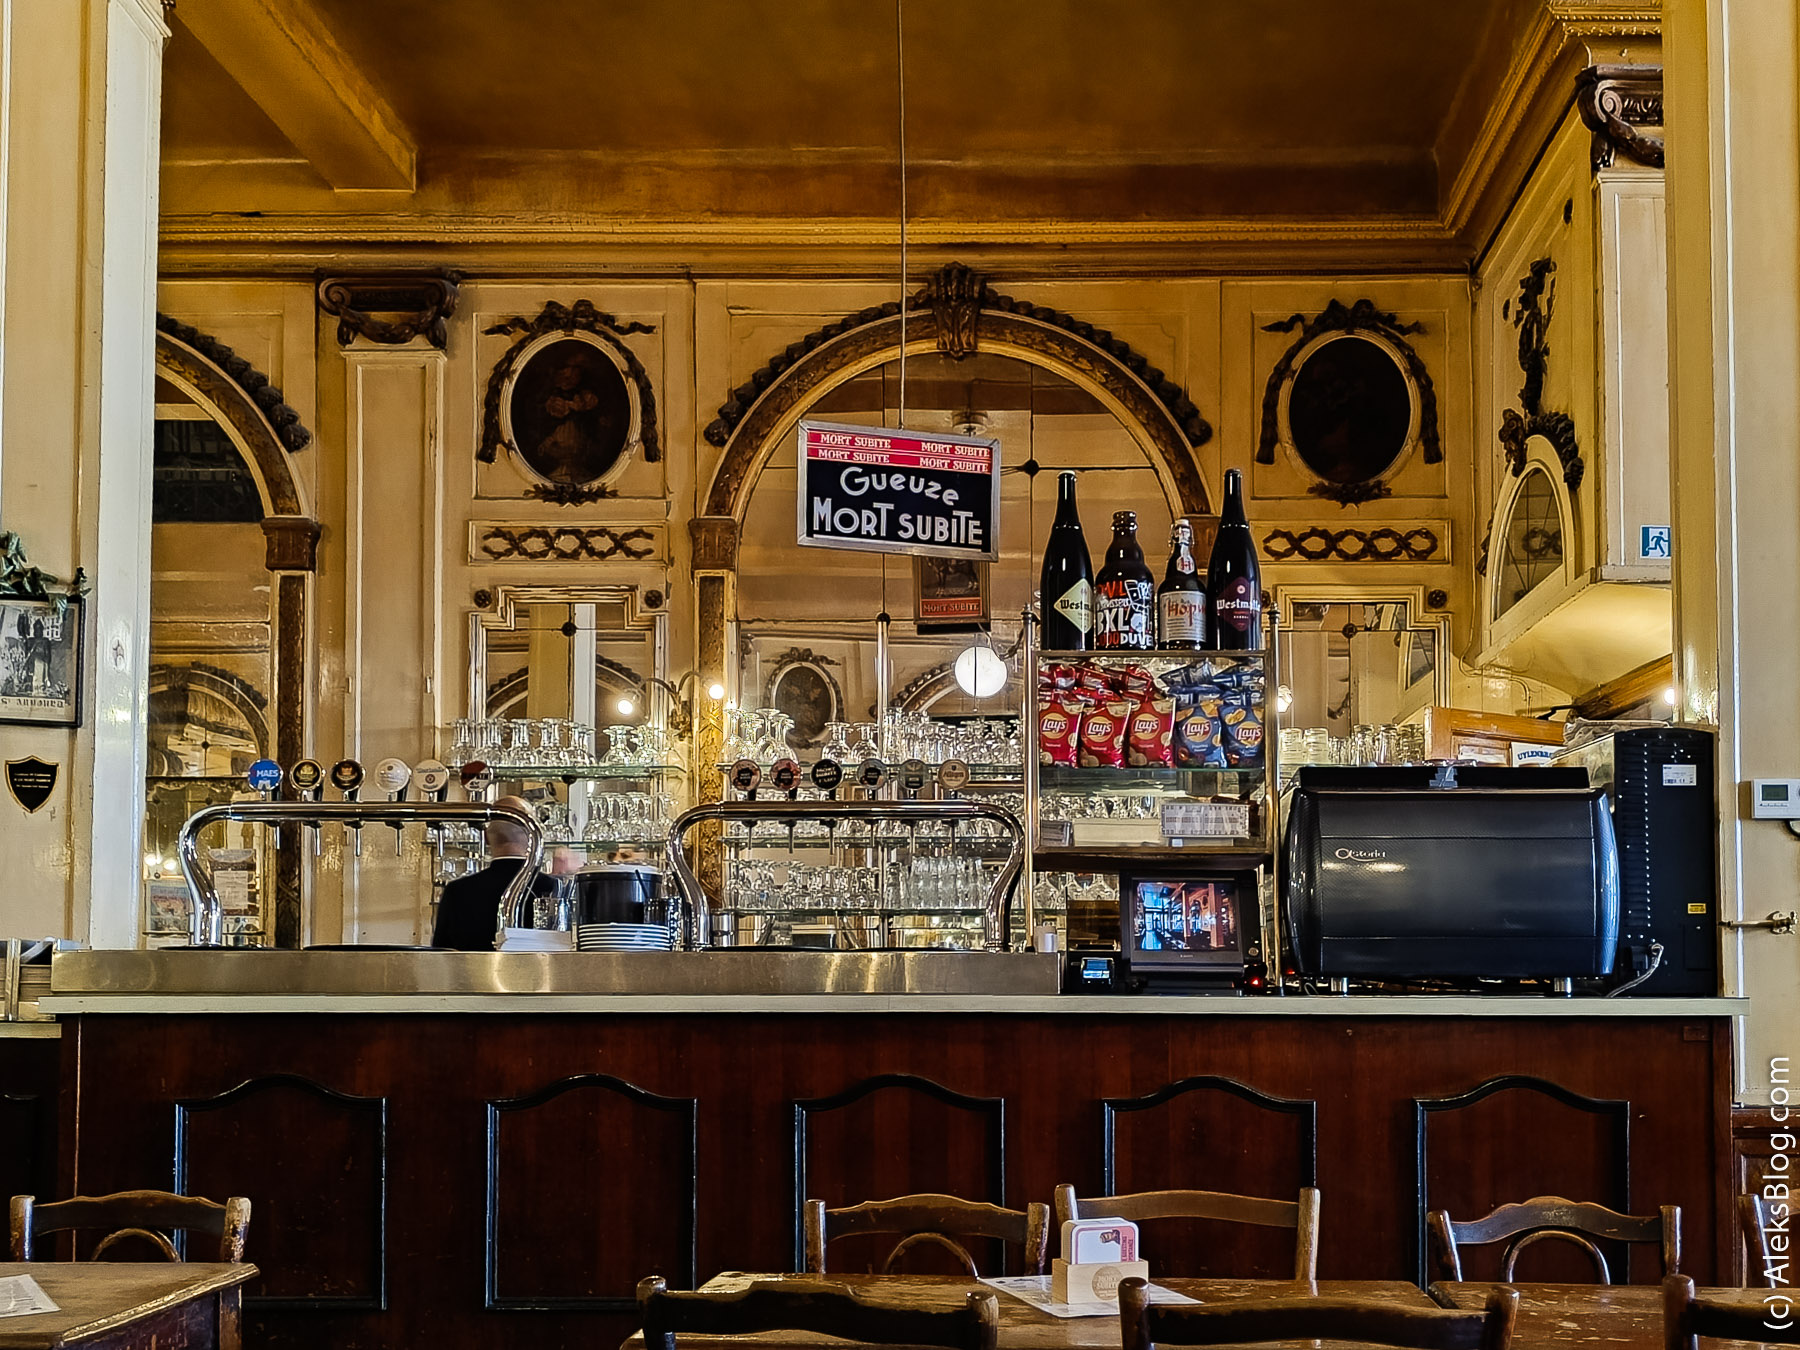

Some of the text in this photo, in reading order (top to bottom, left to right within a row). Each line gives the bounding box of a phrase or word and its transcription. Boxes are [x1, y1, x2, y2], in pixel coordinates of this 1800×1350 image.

[820, 433, 891, 449] MORT SUBITE
[818, 449, 890, 463] MORT SUBITE
[921, 442, 990, 458] MORT SUBITE
[919, 457, 989, 473] MORT SUBITE
[813, 497, 983, 546] MORT SUBITE
[923, 602, 980, 612] MORT SUBITE
[256, 769, 279, 777] MAES
